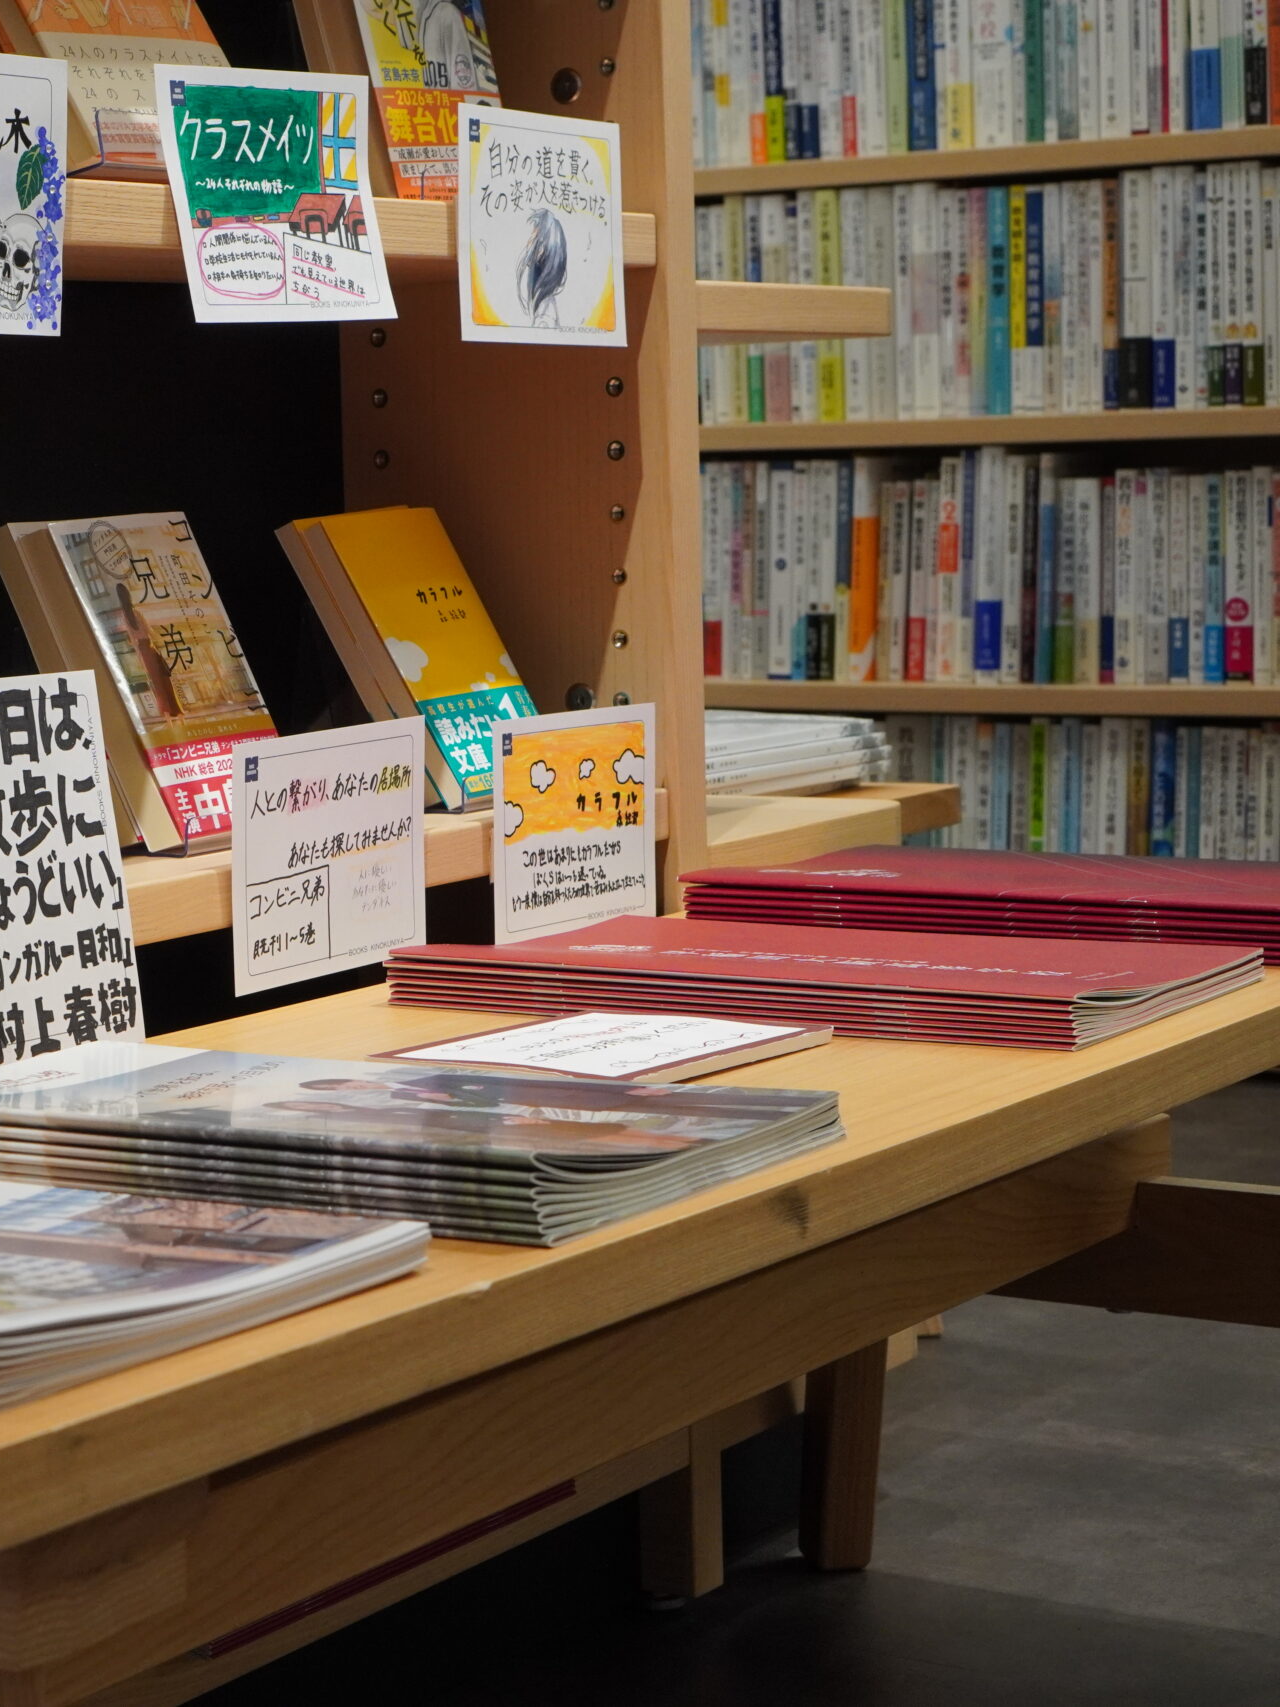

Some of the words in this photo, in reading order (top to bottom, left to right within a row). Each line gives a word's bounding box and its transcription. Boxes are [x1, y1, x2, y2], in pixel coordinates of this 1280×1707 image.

[179, 109, 315, 166] クラスメイツ
[385, 106, 459, 145] 舞台化
[488, 137, 594, 186] 自分の道を貫く。
[480, 179, 608, 227] その姿が人を惹きつける。
[292, 281, 320, 300] ちがう
[129, 556, 195, 672] 兄弟
[415, 584, 463, 605] カラフル
[173, 765, 198, 780] NHK
[198, 761, 215, 776] 総合
[174, 788, 203, 835] 主演
[576, 791, 638, 812] カラフル
[287, 816, 412, 869] あなたも探してみませんか?
[249, 875, 325, 920] コンビニ兄弟
